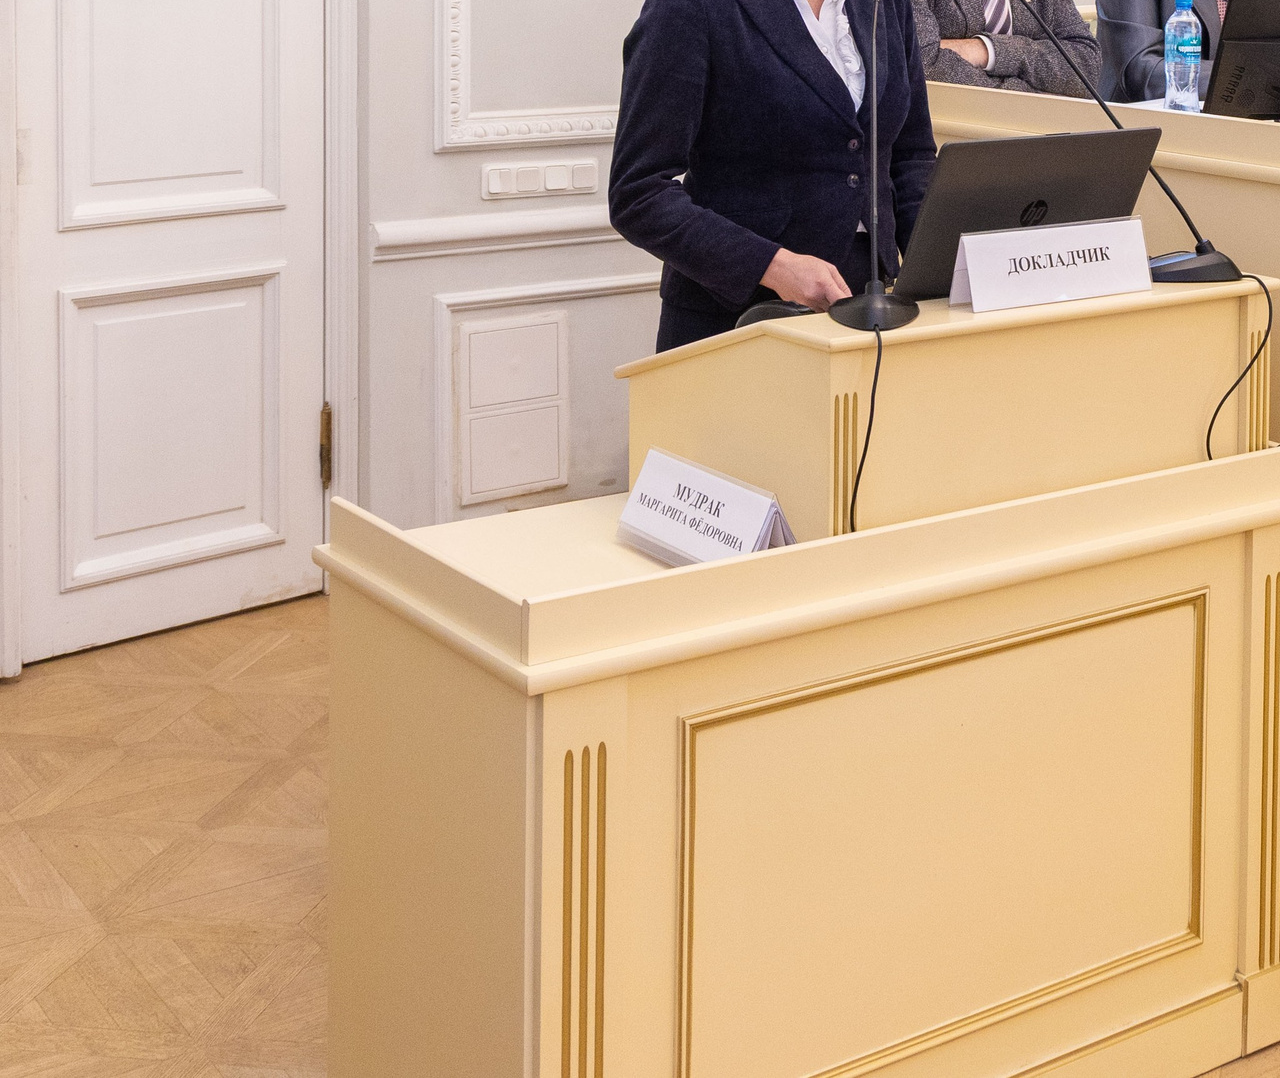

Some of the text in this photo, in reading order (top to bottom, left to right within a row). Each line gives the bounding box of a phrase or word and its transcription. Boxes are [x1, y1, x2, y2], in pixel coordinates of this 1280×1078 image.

[1008, 246, 1111, 276] ДОКЛАДЧИК
[673, 483, 725, 519] МУДРАК
[637, 492, 743, 552] МАРГАРИТА ФЁДОРОВНА
